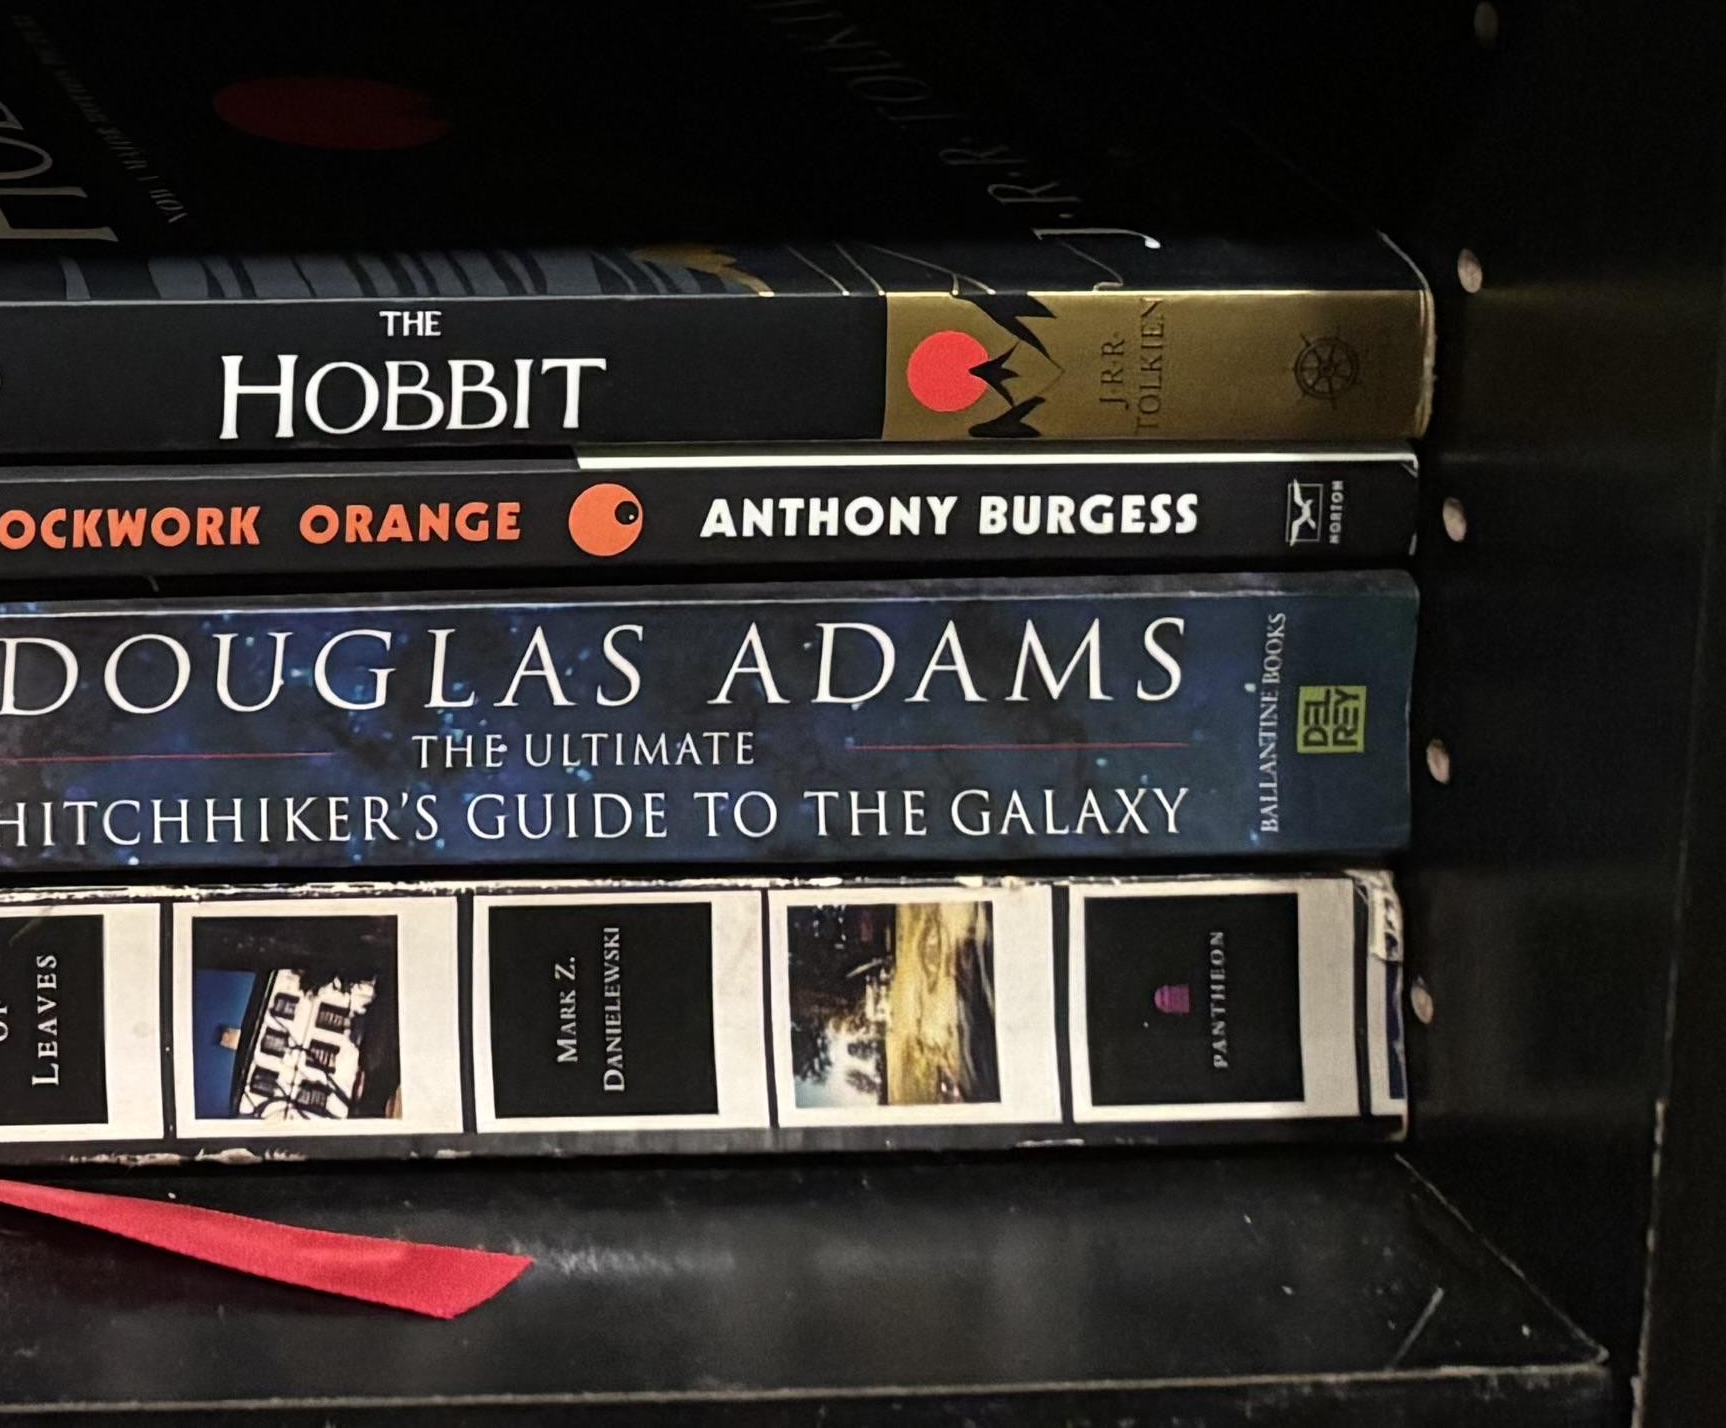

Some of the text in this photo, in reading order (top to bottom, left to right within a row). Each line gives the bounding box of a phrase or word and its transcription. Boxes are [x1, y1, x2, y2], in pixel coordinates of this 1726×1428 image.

[378, 310, 443, 337] THE
[218, 353, 608, 440] HOBBIT
[299, 501, 521, 545] ORANGE
[699, 492, 1199, 538] ANTHONY BURGESS
[706, 616, 1185, 711] ADAMS
[411, 731, 755, 775] THE ULTIMATE
[465, 792, 668, 840] GUIDE
[693, 790, 778, 838] TO
[803, 790, 927, 837] THE
[950, 787, 1189, 837] GALAXY
[31, 954, 60, 1086] LEAVES
